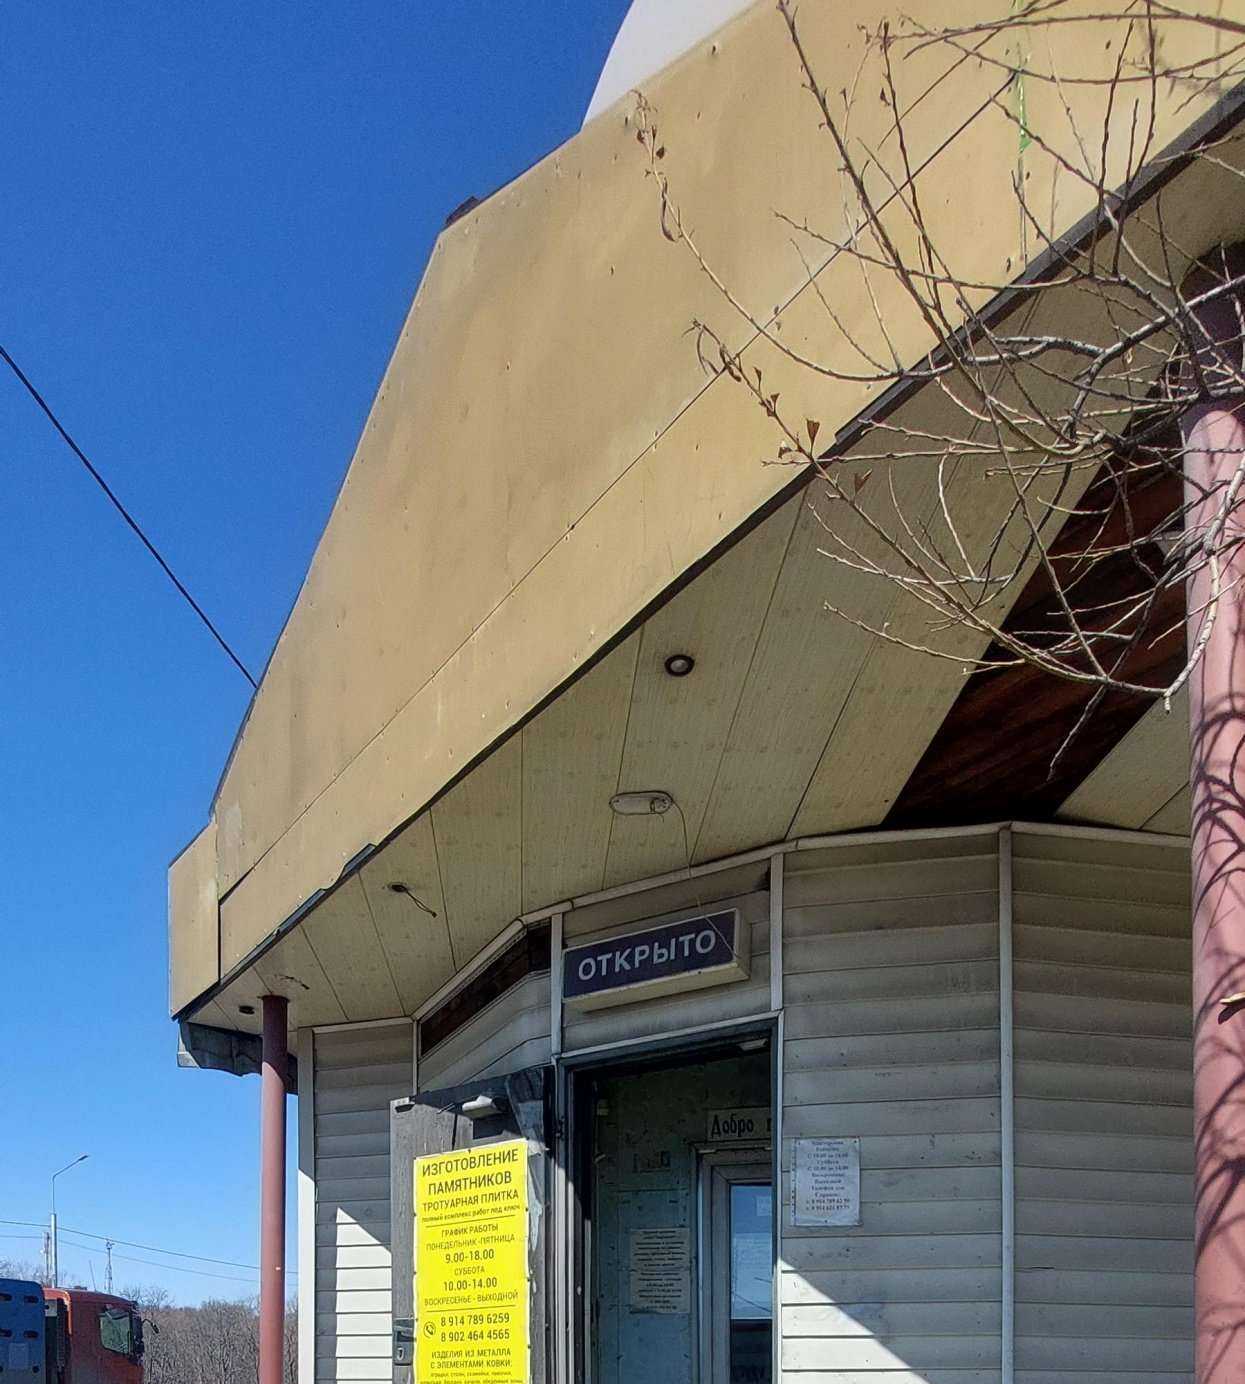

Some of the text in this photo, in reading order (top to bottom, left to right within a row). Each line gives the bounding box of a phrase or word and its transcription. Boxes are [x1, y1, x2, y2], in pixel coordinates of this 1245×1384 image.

[578, 929, 716, 981] ОТКРЫТО
[711, 1113, 754, 1138] Добро
[422, 1148, 519, 1177] ИЗГОТОВЛЕНИЕ
[428, 1170, 512, 1195] ПАМЯТНИКОВ
[422, 1189, 519, 1212] ТРОТУАРНАЯ ПЛИТКА
[441, 1224, 499, 1238] ГРАФИК РАБОТЫ
[454, 1265, 485, 1276] СУББОТА
[424, 1295, 472, 1306] ВОСКРЕСЕНЬЕ
[477, 1289, 519, 1302] ВЫХОДНОЙ
[441, 1312, 510, 1327] 8 914 789 6259
[441, 1328, 510, 1342] 8 902 464 4565
[431, 1348, 511, 1359] ИЗДЕЛИЯ ИЗ МЕТАЛЛА
[437, 1360, 484, 1369] ЭЛЕМЕНТАМИ
